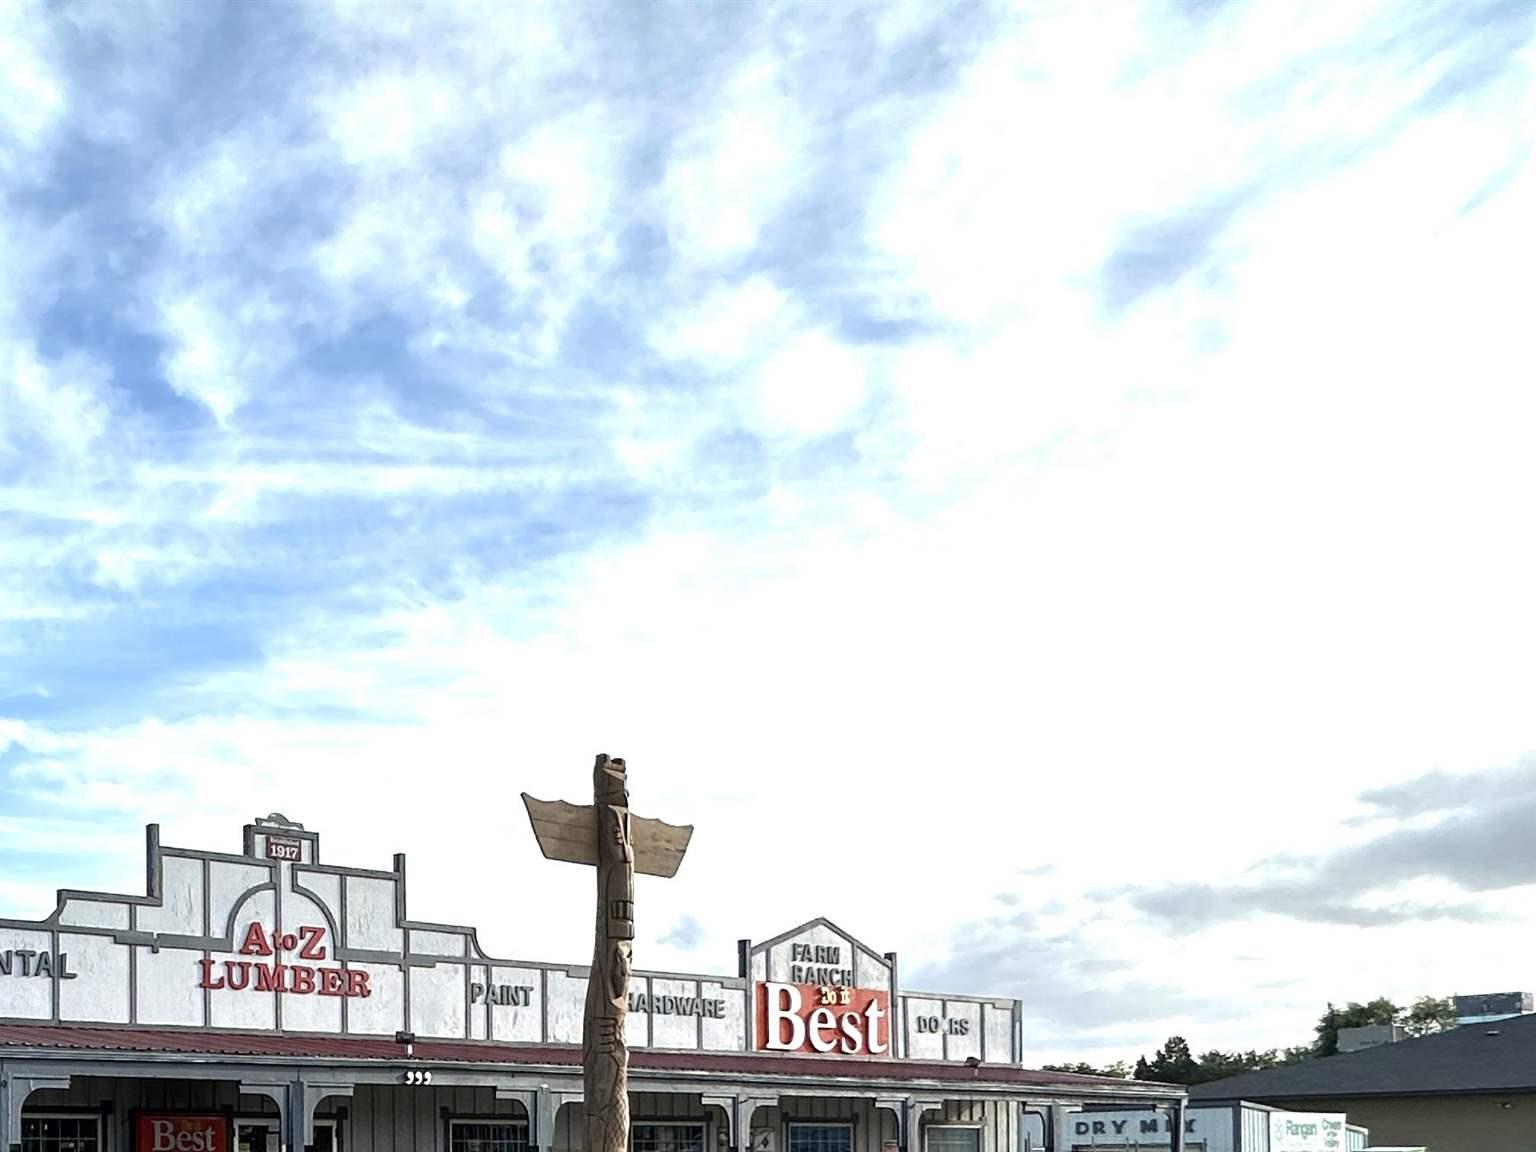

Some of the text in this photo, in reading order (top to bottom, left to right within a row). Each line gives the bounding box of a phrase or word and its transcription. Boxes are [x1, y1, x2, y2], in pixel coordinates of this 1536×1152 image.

[270, 845, 299, 859] 1917
[791, 943, 841, 965] FARM
[199, 959, 372, 998] LUMBER
[791, 965, 853, 987] RANCH
[471, 982, 535, 1006] PAINT
[821, 986, 852, 1006] Do it
[764, 981, 888, 1054] Best
[916, 1015, 970, 1036] DORS
[151, 1120, 217, 1152] Best
[1075, 1120, 1127, 1135] DRY
